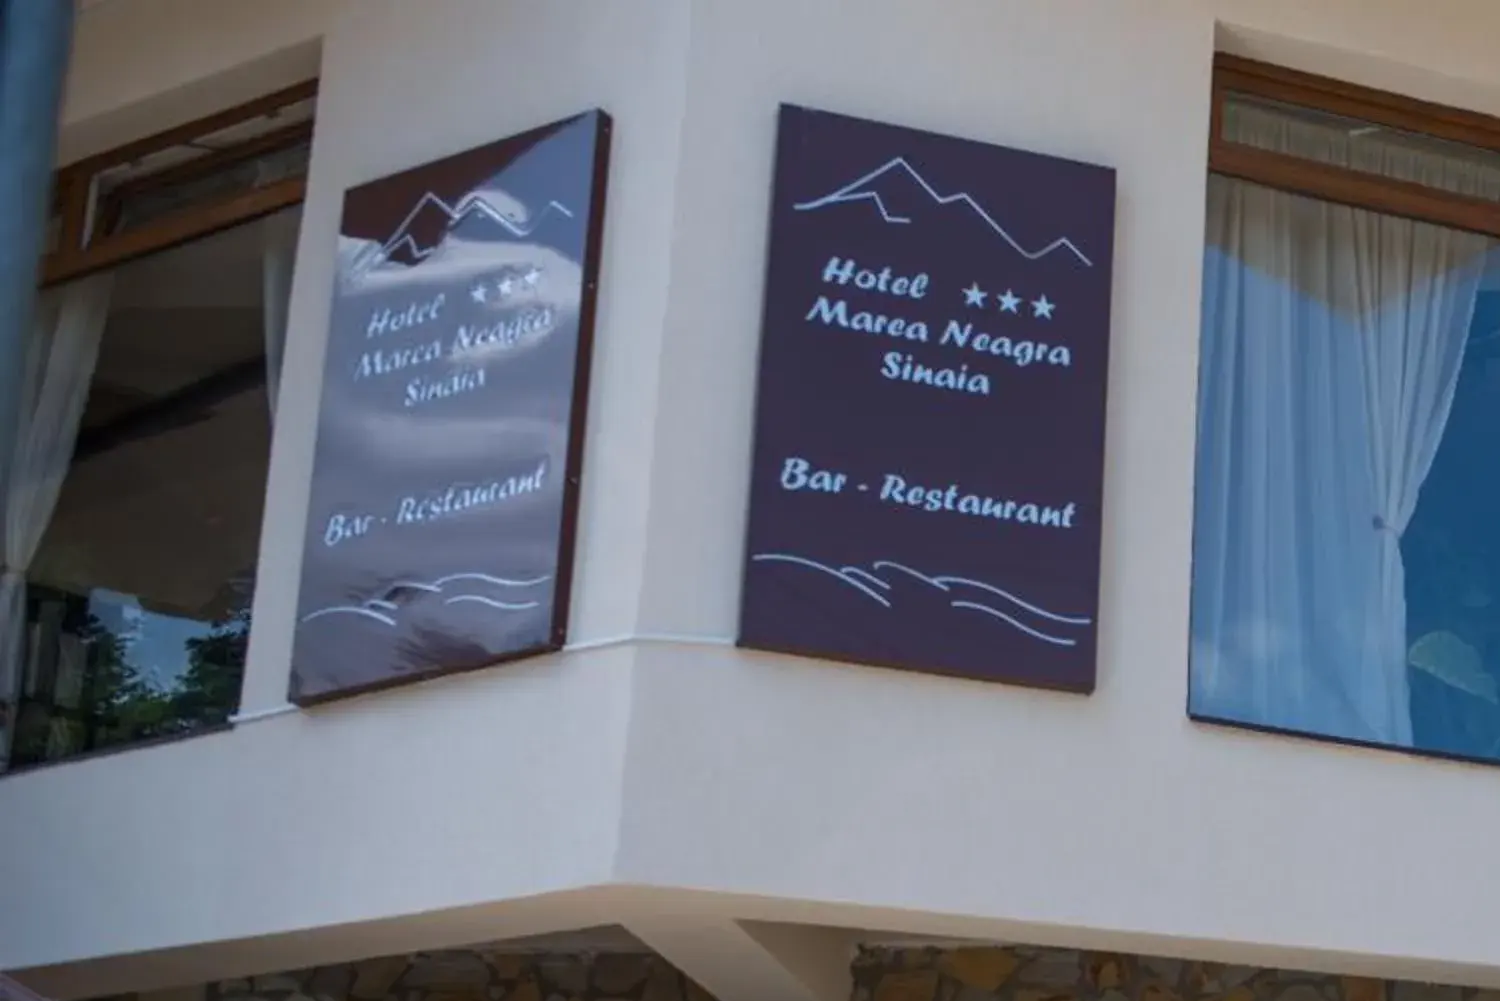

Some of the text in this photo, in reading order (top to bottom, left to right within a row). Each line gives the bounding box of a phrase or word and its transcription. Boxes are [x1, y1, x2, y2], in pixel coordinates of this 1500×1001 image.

[822, 256, 929, 298] Hotel
[354, 307, 552, 383] Marea Neagra
[365, 291, 446, 340] Hotel
[805, 296, 1071, 367] Marea Neagra
[404, 367, 486, 407] Sinaia
[880, 351, 990, 394] Sinaia
[324, 514, 374, 547] Bar
[396, 459, 547, 526] Restaurant
[780, 457, 847, 493] Bar
[880, 473, 1076, 528] Restaurant
